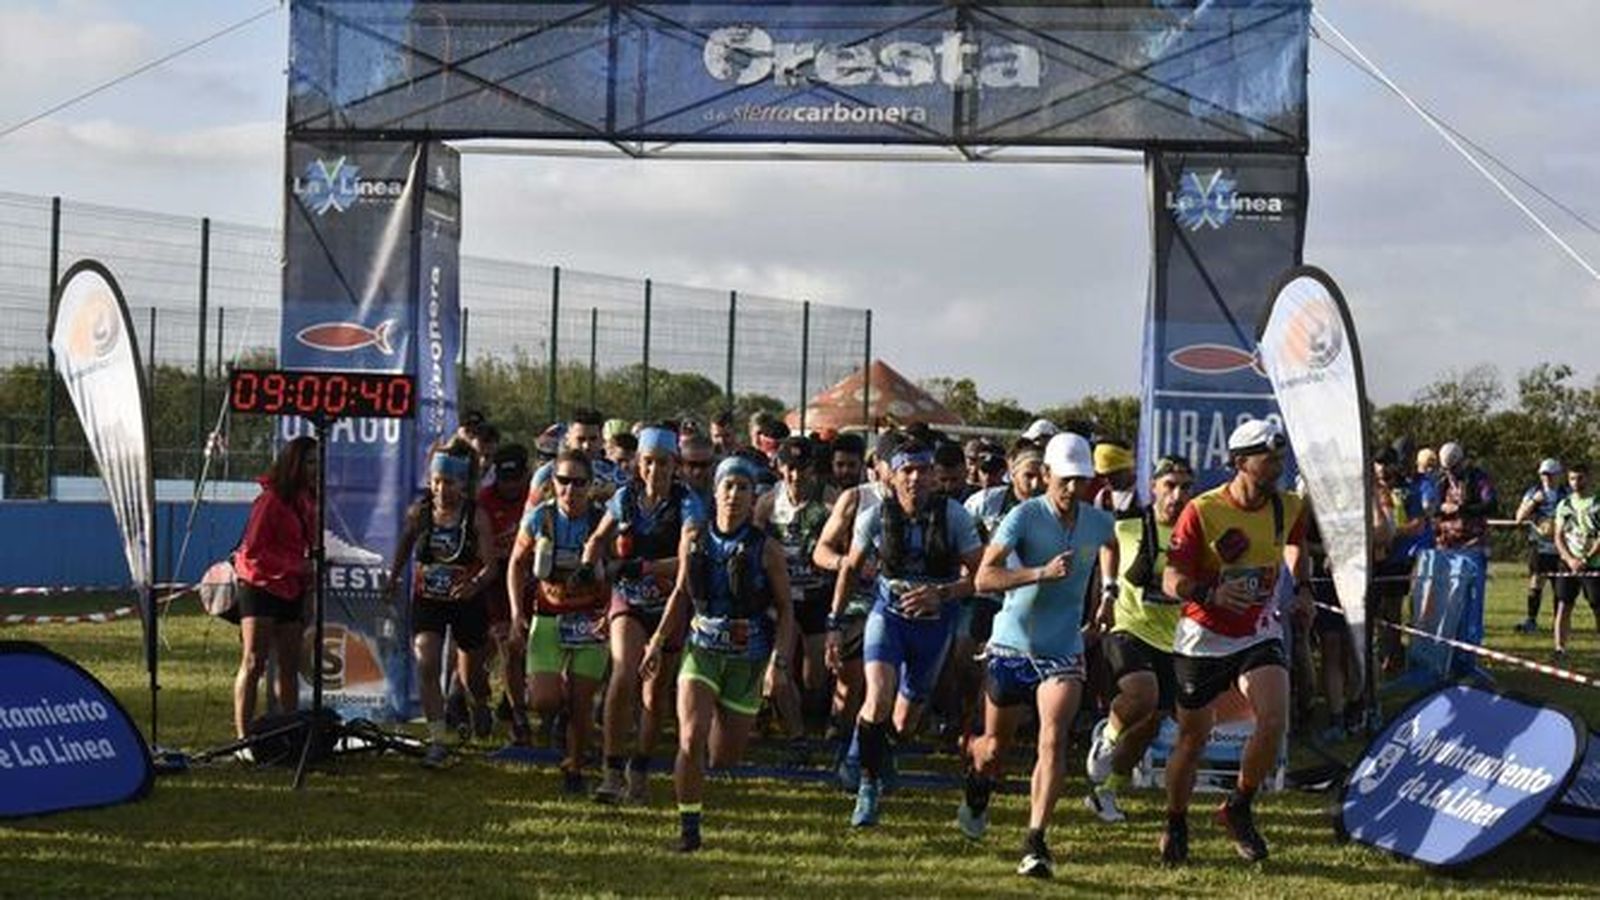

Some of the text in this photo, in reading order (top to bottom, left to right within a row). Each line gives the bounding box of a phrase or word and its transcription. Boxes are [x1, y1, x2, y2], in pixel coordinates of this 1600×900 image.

[703, 24, 1041, 89] Cresta
[293, 177, 320, 194] La
[234, 372, 410, 415] 09:00:40
[10, 739, 48, 766] La
[1411, 729, 1553, 794] Ayuntamiento
[1398, 772, 1427, 800] de
[1419, 779, 1448, 811] La
